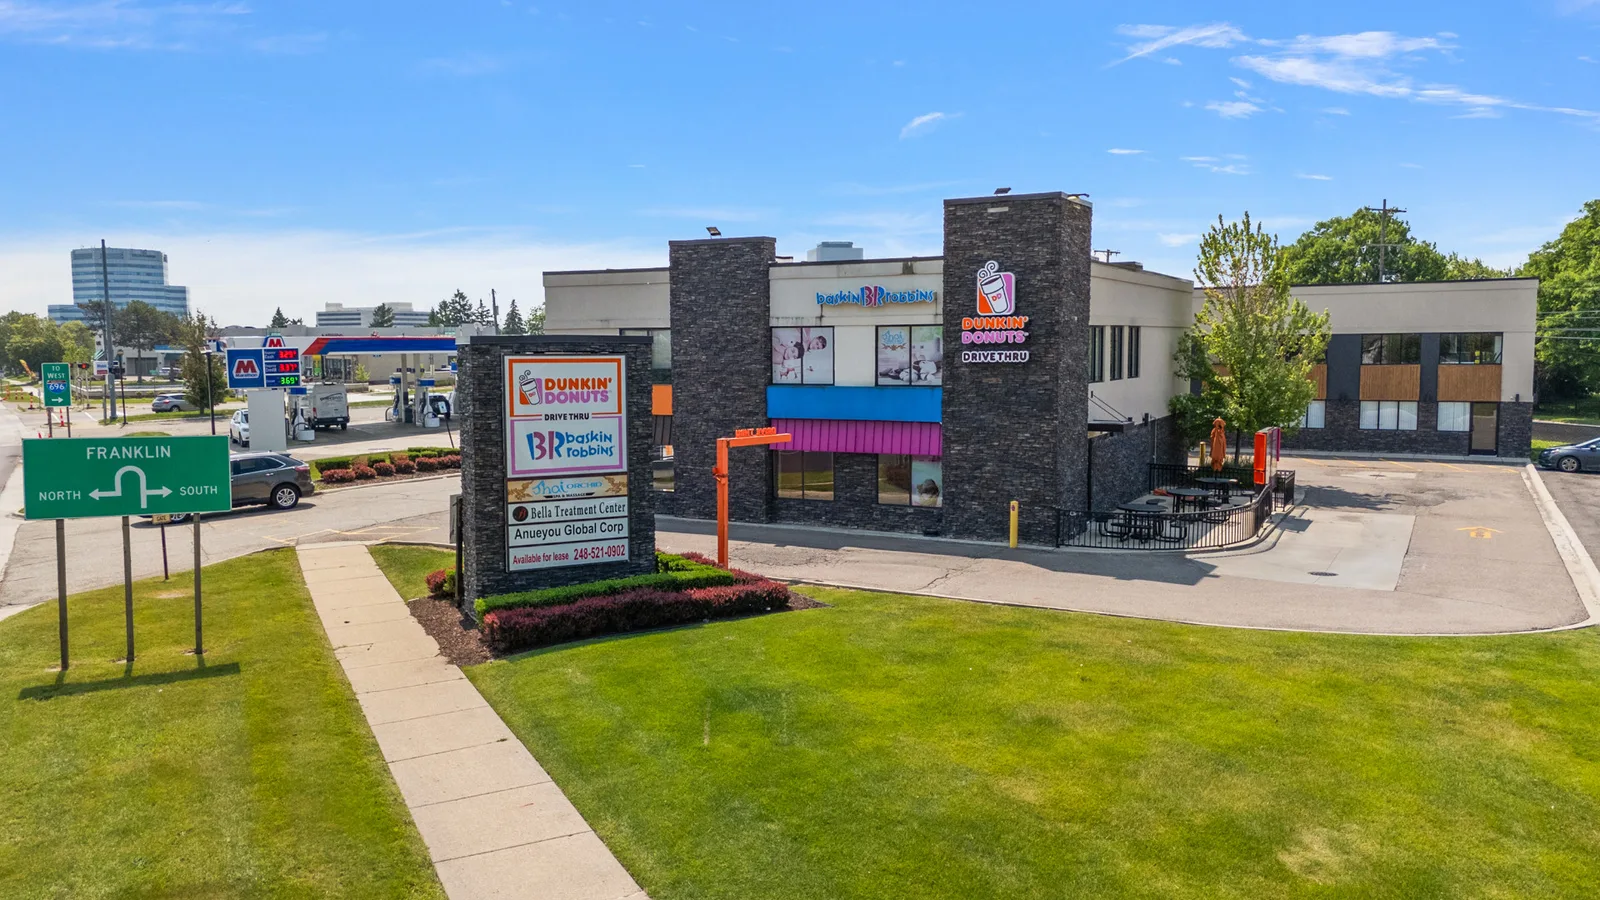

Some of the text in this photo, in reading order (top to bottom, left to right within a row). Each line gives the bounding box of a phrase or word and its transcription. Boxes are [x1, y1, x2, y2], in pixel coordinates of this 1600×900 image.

[860, 285, 885, 307] BR
[991, 293, 1002, 301] DD
[962, 316, 1028, 330] DUNKIN'
[962, 331, 1026, 344] DONUTS
[963, 351, 1028, 362] DRIVE THRU
[544, 377, 612, 391] DUNKIN'
[544, 390, 609, 404] DONUTS
[544, 412, 590, 421] DRIVE THRU
[86, 445, 171, 459] FRANKLIN
[526, 431, 565, 460] BR
[39, 485, 218, 501] NORTH SOUTH
[532, 480, 568, 495] Thai
[531, 502, 626, 519] Bella Treatment Center
[514, 522, 624, 540] Anueyou Global Corp
[512, 545, 625, 564] Available for lease 248-521-0902
